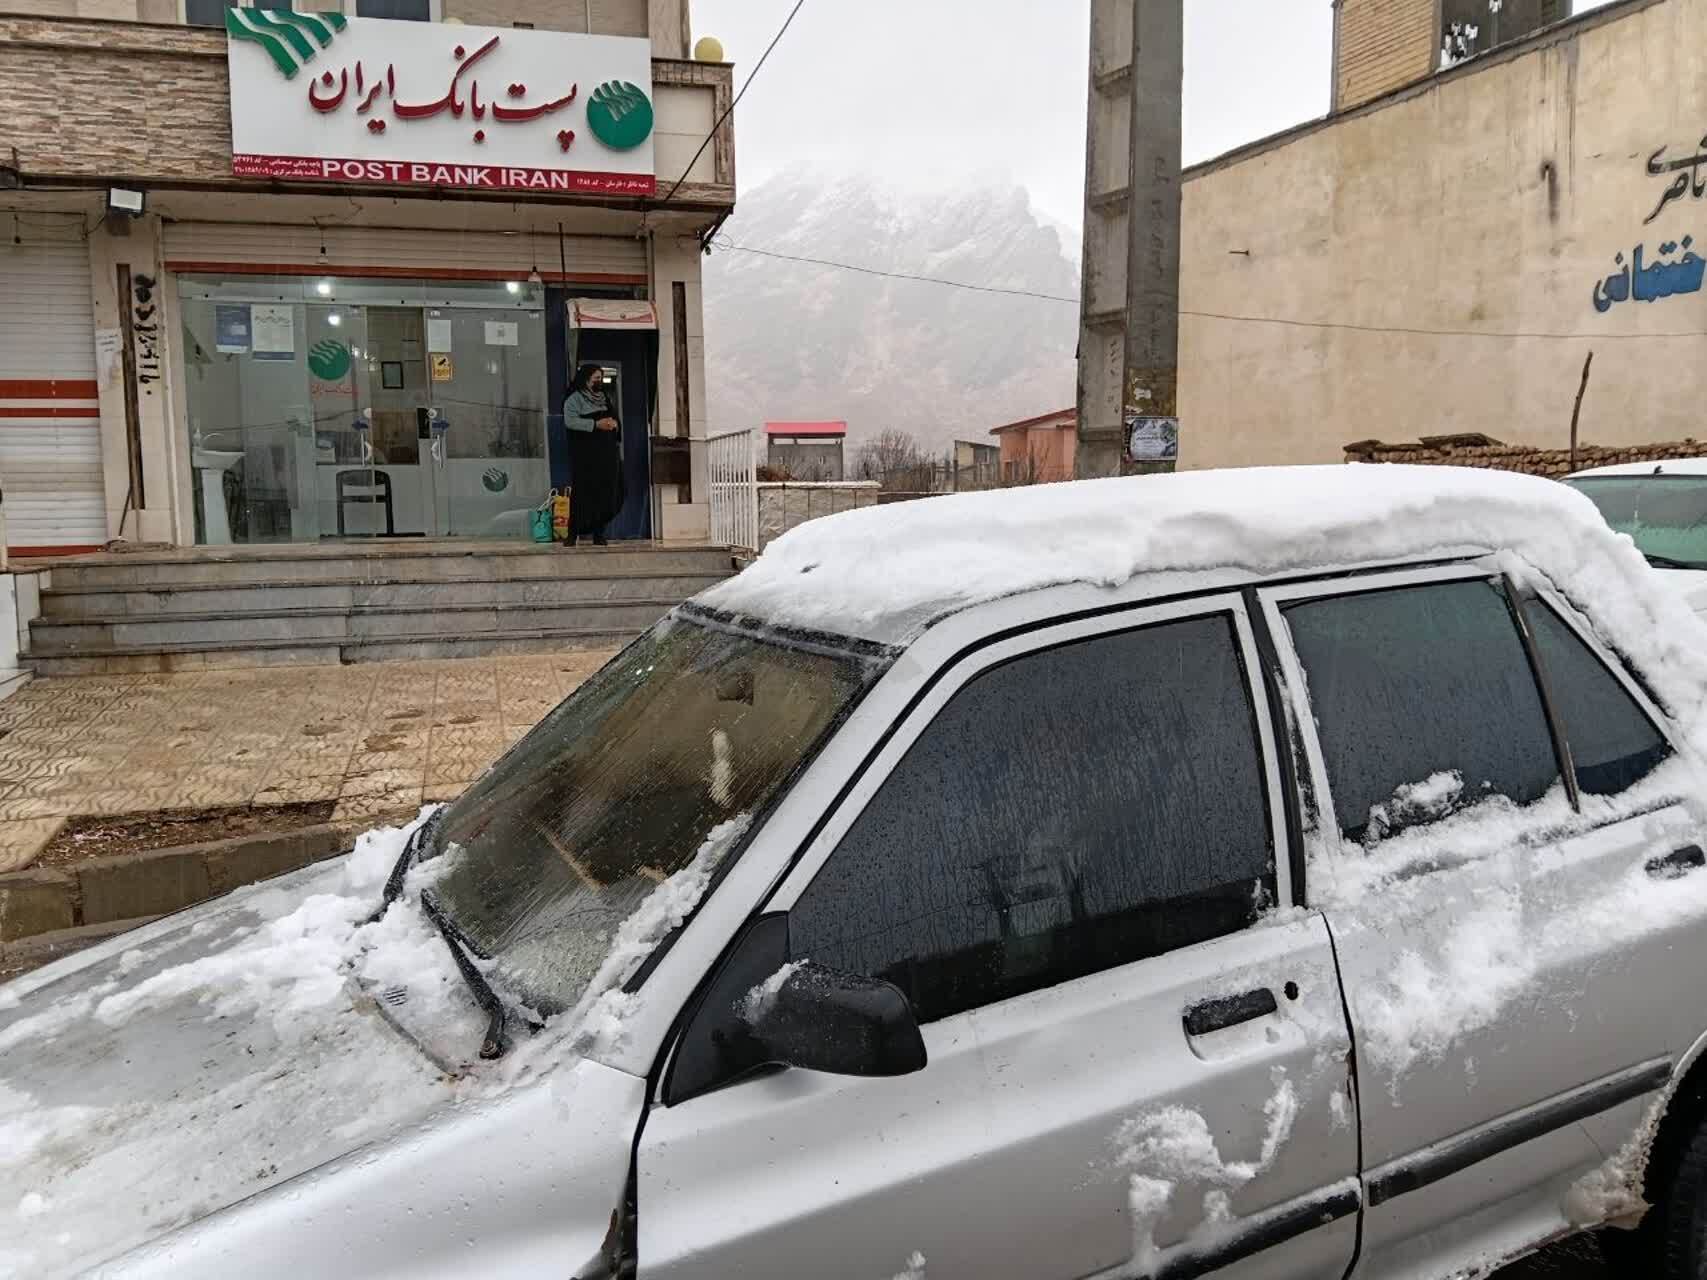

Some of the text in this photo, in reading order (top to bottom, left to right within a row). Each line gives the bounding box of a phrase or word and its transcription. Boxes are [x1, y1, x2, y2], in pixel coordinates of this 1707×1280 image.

[308, 35, 577, 153] پست بانک ایران
[322, 161, 569, 189] POST BANK IRAN
